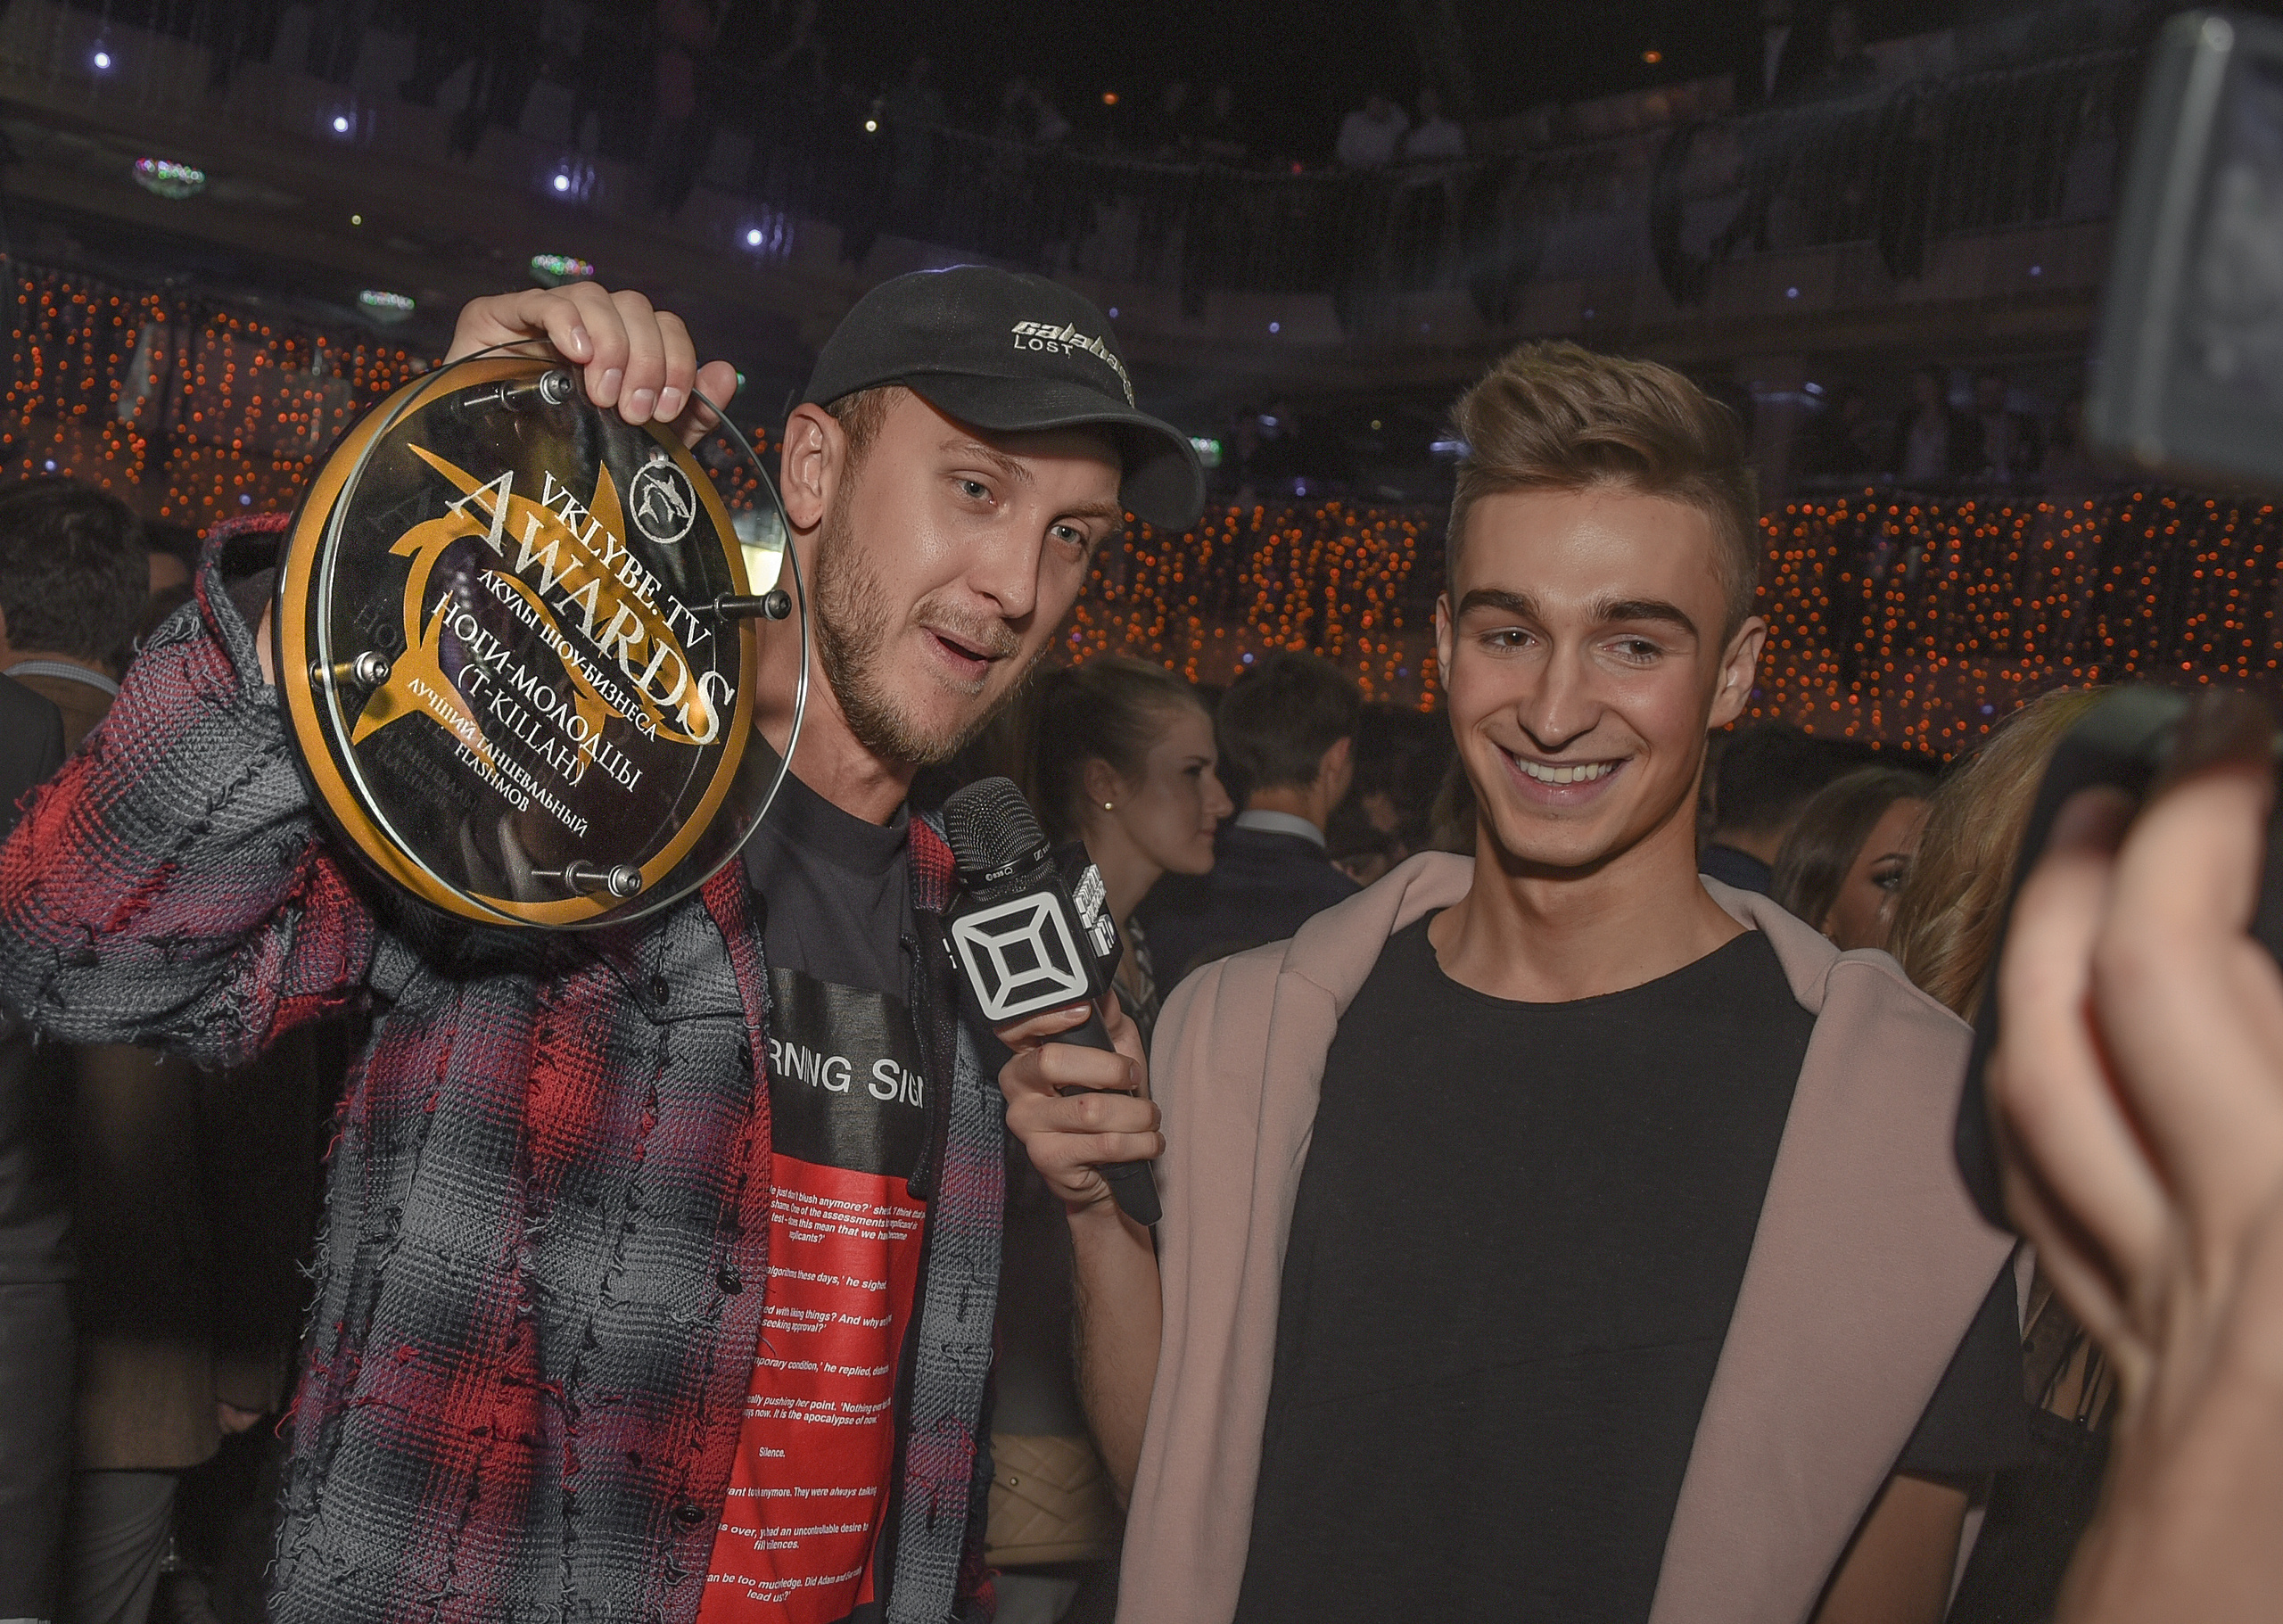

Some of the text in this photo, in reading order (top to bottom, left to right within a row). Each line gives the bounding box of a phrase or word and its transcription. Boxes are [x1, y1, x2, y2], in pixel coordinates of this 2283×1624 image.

[1014, 334, 1073, 359] LOST
[445, 470, 736, 746] AWARDS
[477, 570, 658, 743] АКУЛЫ ШОУ-БИЗНЕСА
[431, 592, 643, 793] НОГИ-МОЛОДЦЫ
[457, 664, 585, 787] (T-KILLAH)
[408, 678, 589, 838] ЛУЧШИЙ ТАНЦЕВАЛЬНЫЙ
[455, 742, 530, 812] FLASHMOB
[799, 1192, 818, 1204] blush
[800, 1206, 809, 1216] of
[809, 1207, 822, 1218] the
[822, 1211, 886, 1228] assessments
[798, 1218, 813, 1229] this
[813, 1222, 836, 1233] mean
[837, 1224, 860, 1237] that
[861, 1231, 877, 1240] we
[797, 1269, 816, 1282] these
[846, 1276, 860, 1288] he
[761, 1319, 792, 1332] seeking
[776, 1307, 790, 1317] with
[804, 1309, 837, 1322] things?
[838, 1314, 861, 1326] And
[862, 1317, 879, 1329] why
[823, 1363, 837, 1373] he
[838, 1365, 871, 1378] replied,
[763, 1396, 795, 1409] pushing
[795, 1397, 810, 1408] her
[809, 1400, 837, 1411] point.
[754, 1408, 771, 1419] now.
[779, 1408, 787, 1419] is
[787, 1409, 803, 1420] the
[804, 1412, 854, 1427] apocalypse
[854, 1414, 864, 1425] of
[759, 1447, 786, 1458] Silence.
[727, 1487, 746, 1497] ant
[760, 1488, 792, 1499] anymore.
[794, 1486, 810, 1499] They
[811, 1488, 828, 1496] were
[730, 1526, 757, 1538] over,
[779, 1528, 792, 1537] an
[840, 1522, 861, 1533] desire
[705, 1573, 721, 1583] an
[721, 1572, 736, 1583] be
[738, 1575, 756, 1587] too
[804, 1576, 818, 1587] Did
[746, 1589, 772, 1602] lead
